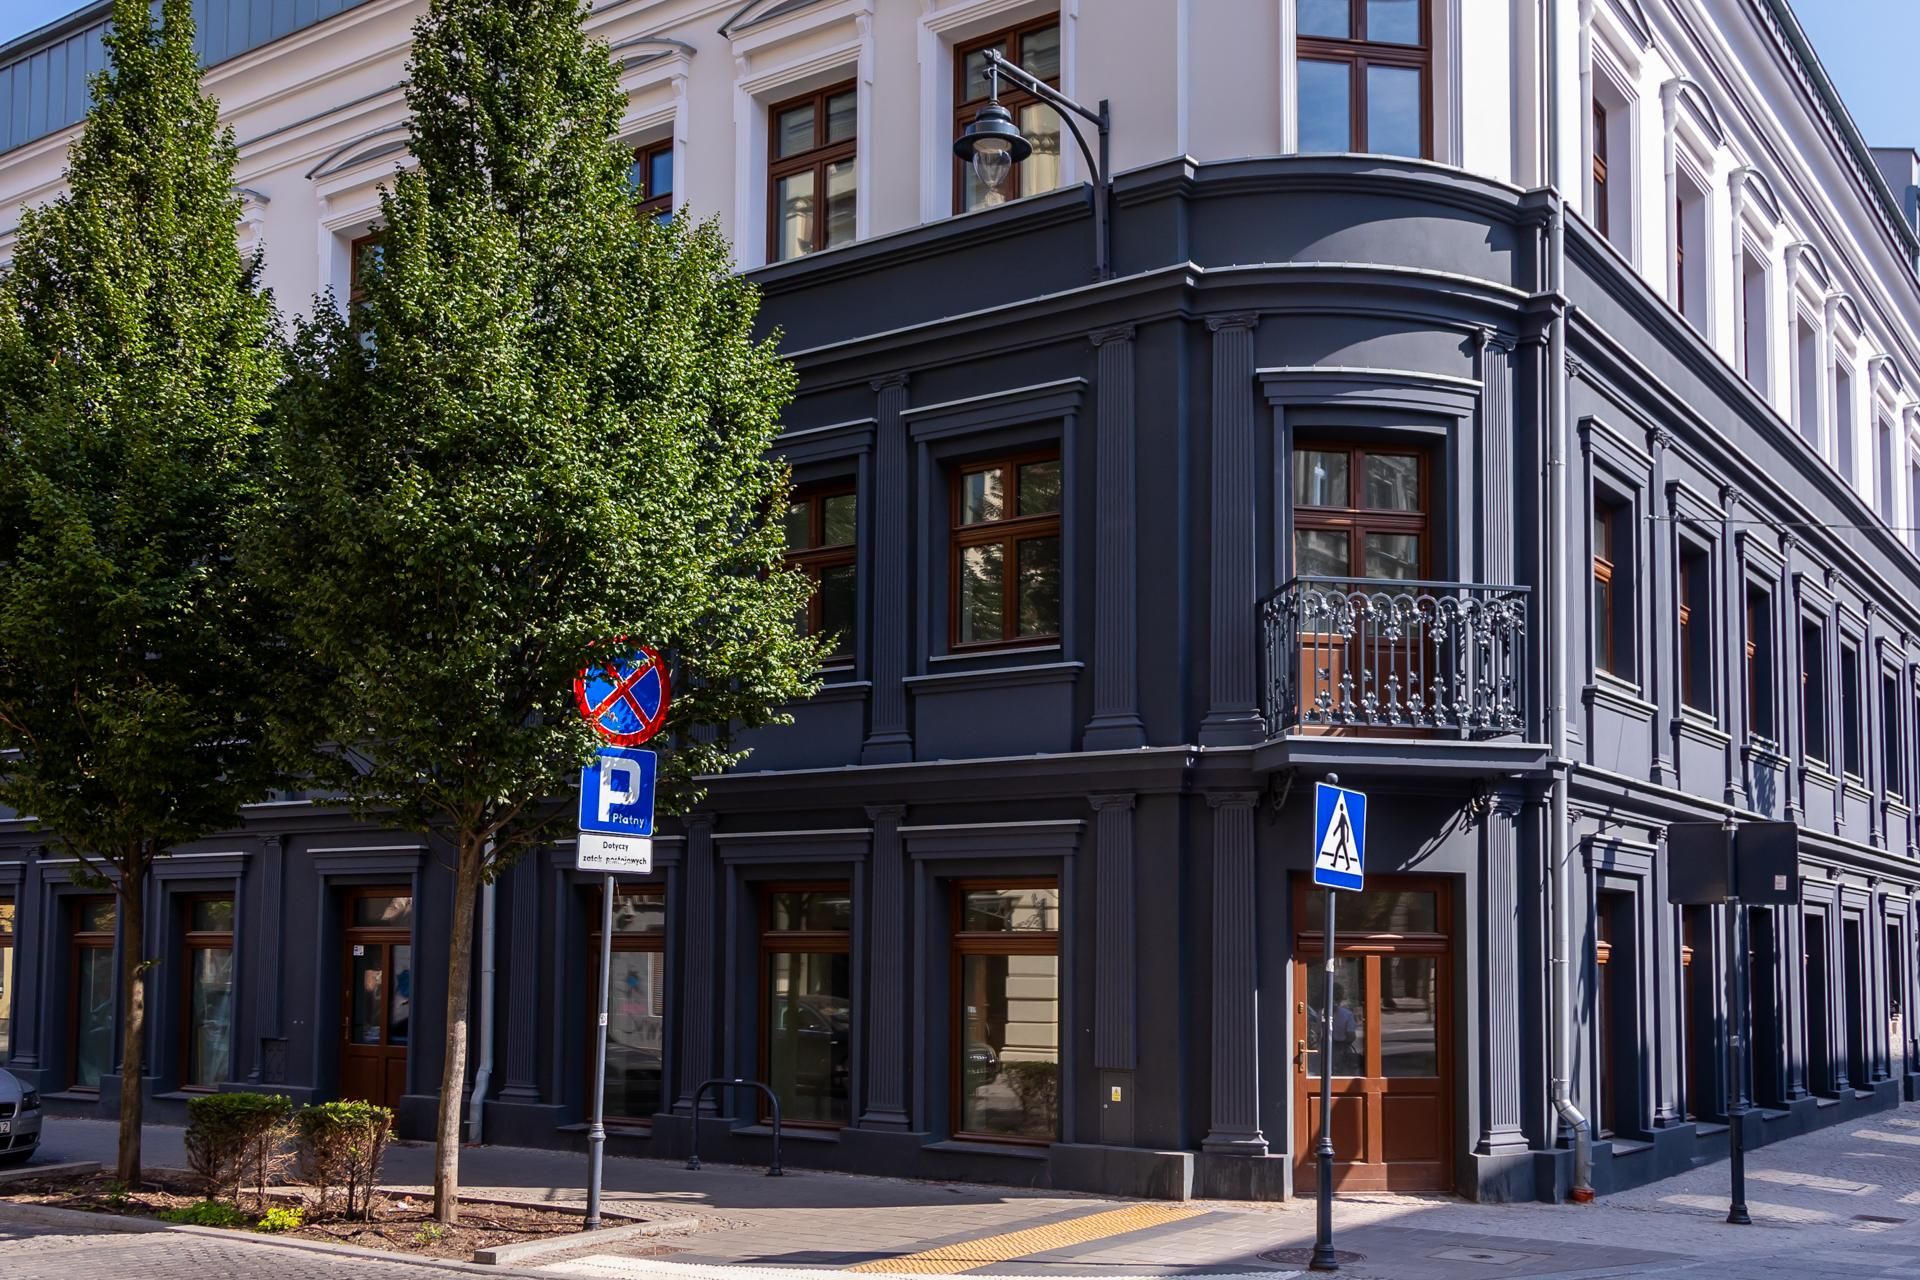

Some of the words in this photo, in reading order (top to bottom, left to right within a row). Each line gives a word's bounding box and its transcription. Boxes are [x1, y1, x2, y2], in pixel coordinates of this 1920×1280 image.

[598, 756, 641, 822] P
[612, 813, 645, 829] Płatny
[603, 841, 629, 852] Dotyczy
